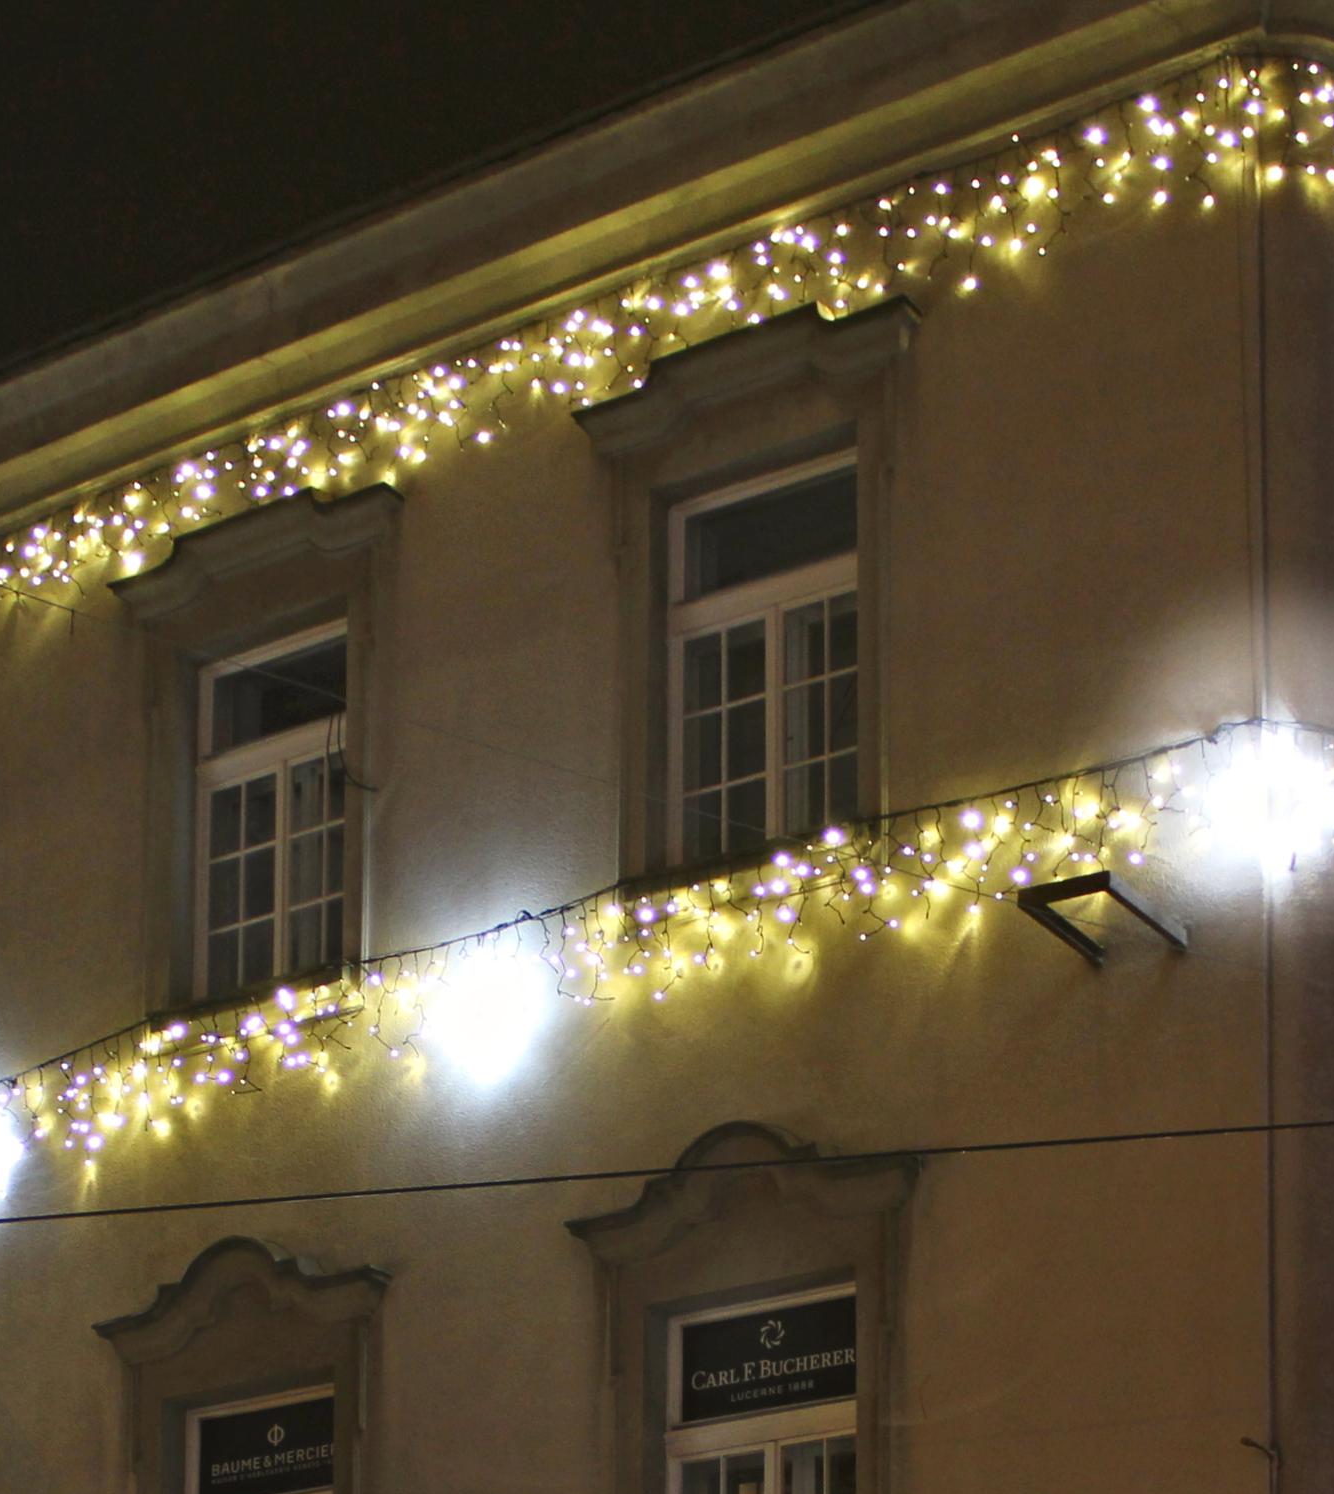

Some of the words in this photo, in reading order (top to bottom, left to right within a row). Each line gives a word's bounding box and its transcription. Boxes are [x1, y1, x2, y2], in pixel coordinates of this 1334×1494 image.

[691, 1368, 740, 1391] CARL
[759, 1348, 855, 1379] BUCHERER
[211, 1456, 261, 1477] BAUME
